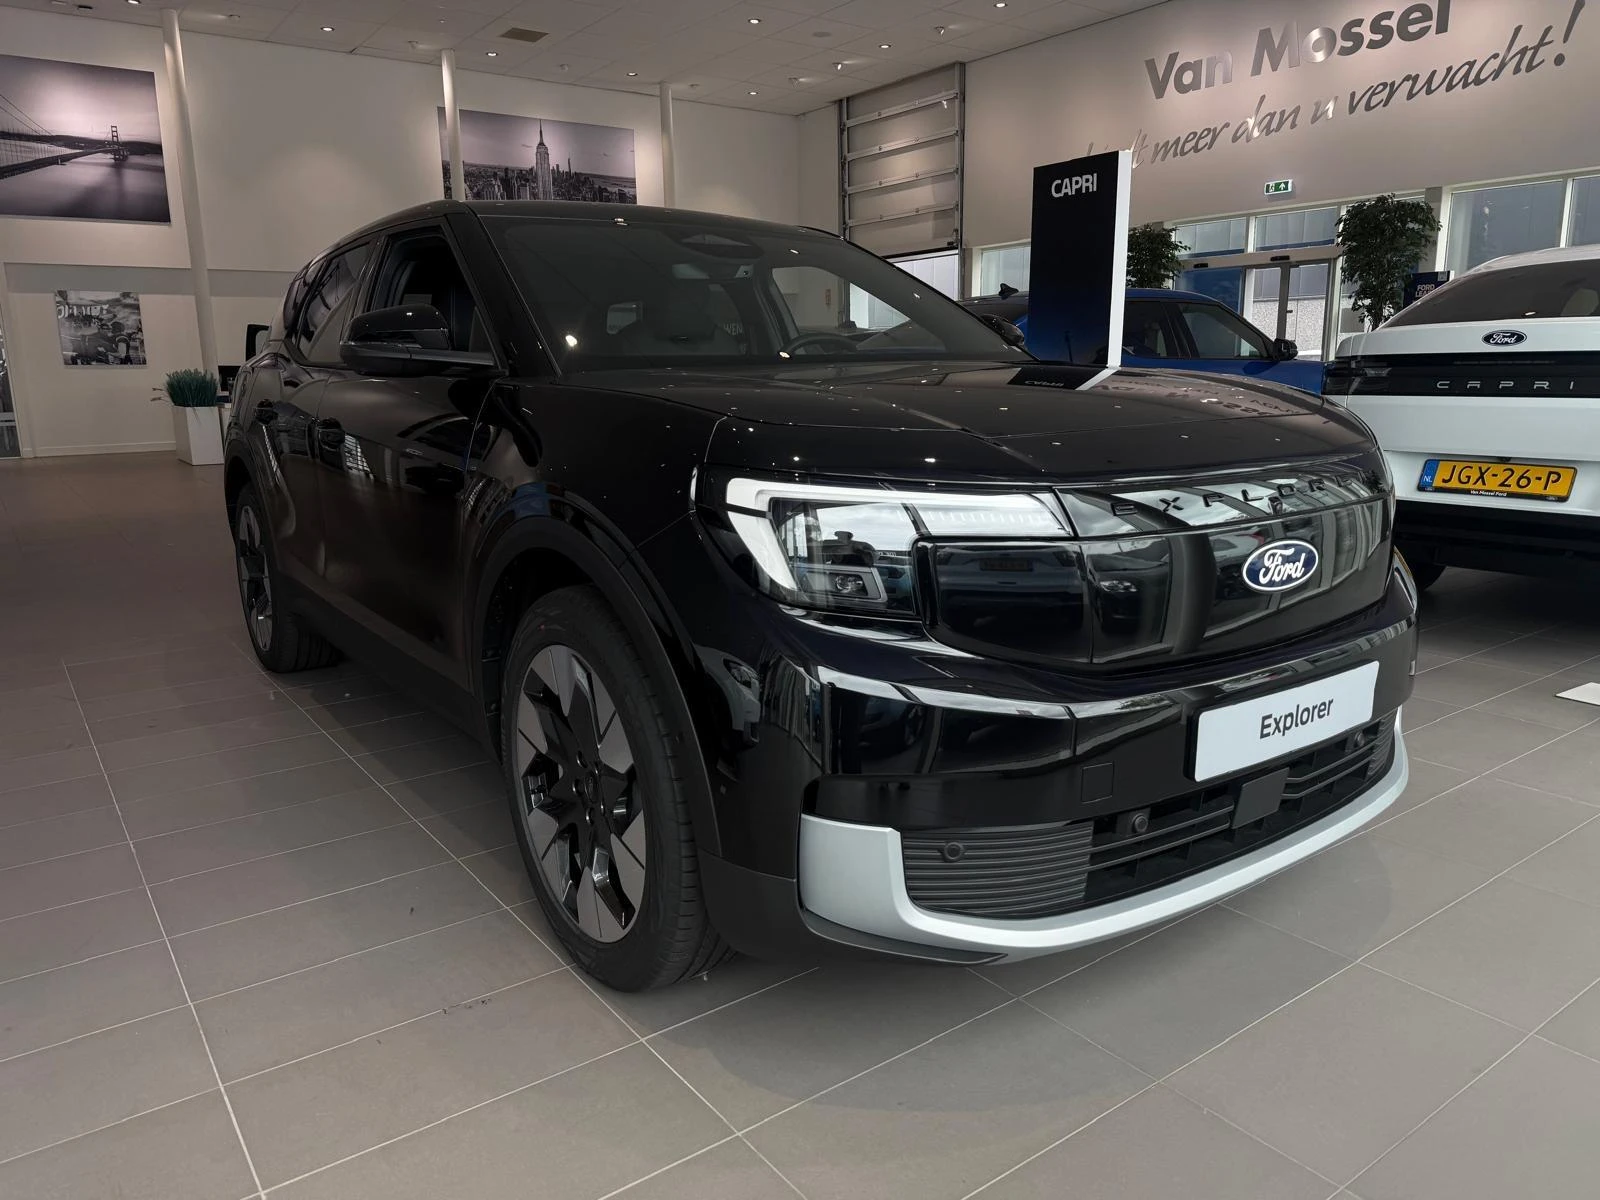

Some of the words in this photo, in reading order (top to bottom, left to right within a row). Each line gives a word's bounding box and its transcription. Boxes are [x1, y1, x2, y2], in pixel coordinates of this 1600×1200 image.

[1145, 51, 1233, 99] Van
[1250, 0, 1451, 77] Mossel
[1150, 121, 1230, 164] meer
[1231, 94, 1301, 143] dan
[1310, 96, 1339, 125] u
[1348, 0, 1586, 115] verwacht!
[1051, 173, 1098, 198] CAPRI
[1416, 284, 1436, 292] FORD
[1490, 332, 1518, 344] Ford
[1436, 380, 1575, 390] CAPRI
[1423, 475, 1433, 483] NL
[1441, 464, 1562, 491] JGX-26-P
[1259, 548, 1305, 585] Ford
[1260, 699, 1334, 739] Explorer
